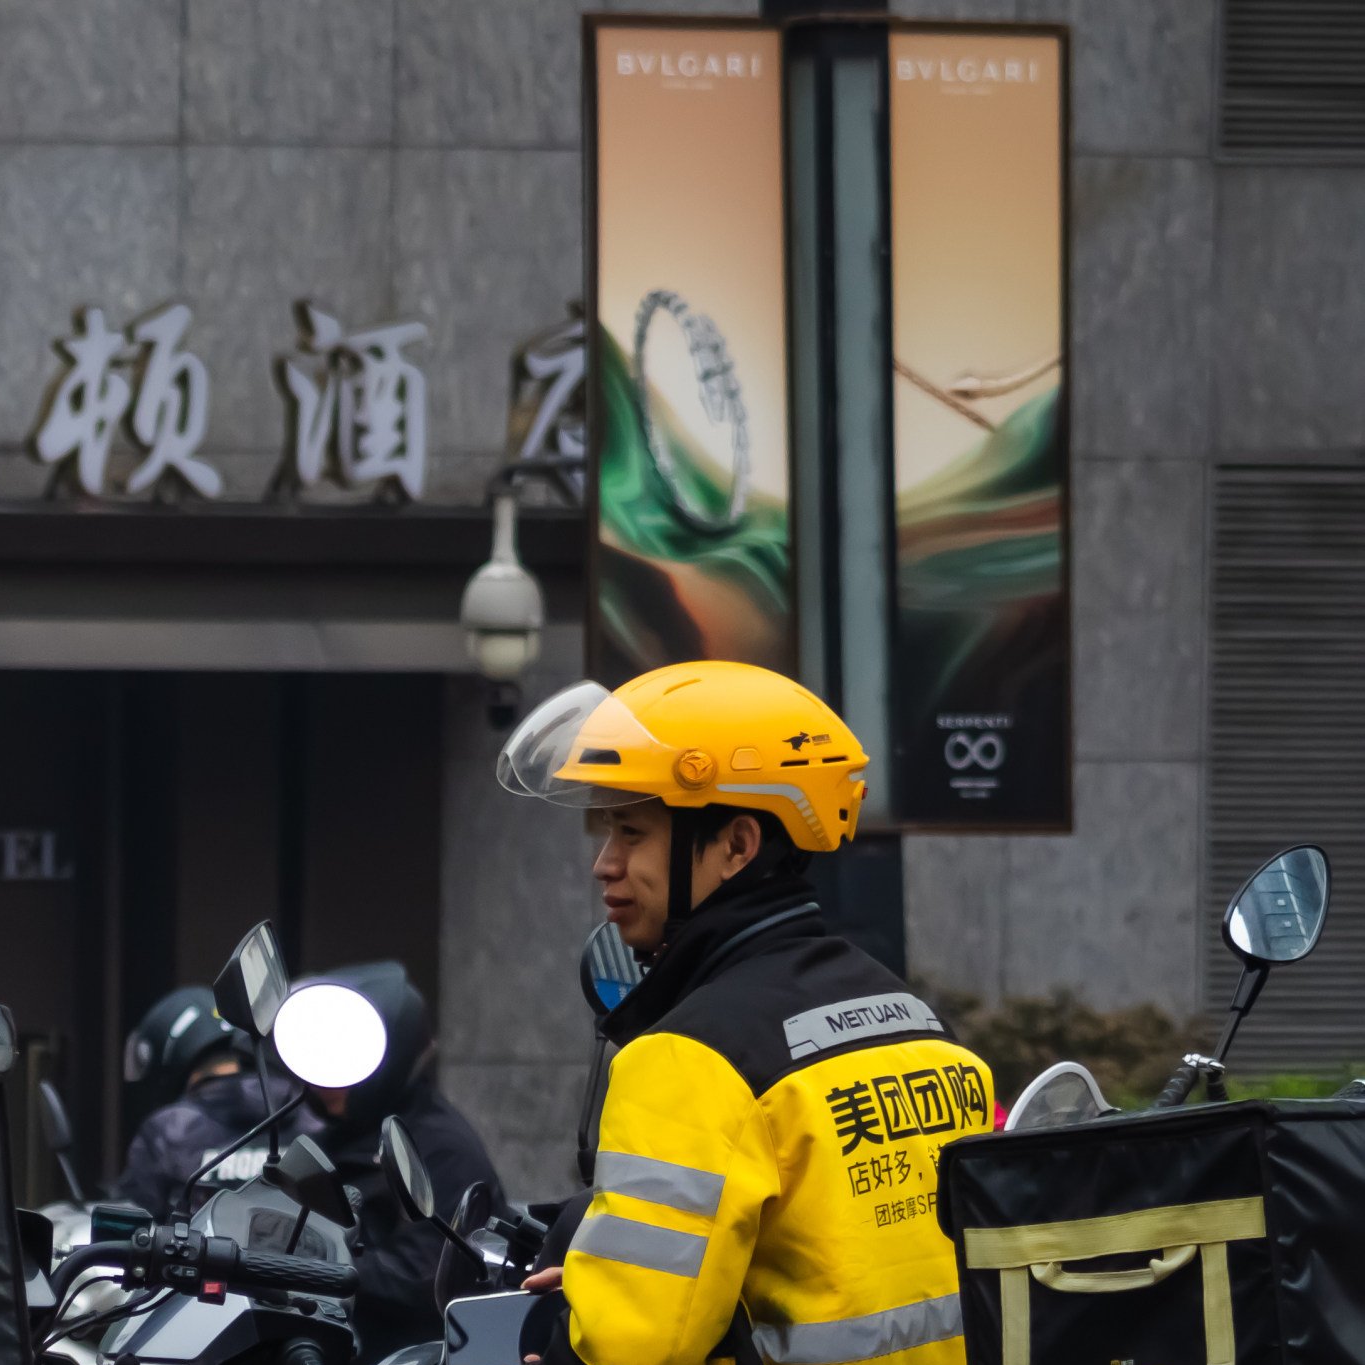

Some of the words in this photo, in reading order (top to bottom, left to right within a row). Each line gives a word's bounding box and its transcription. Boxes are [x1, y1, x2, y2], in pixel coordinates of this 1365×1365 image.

[616, 52, 762, 79] BVLGARI
[896, 57, 1039, 83] BVLGARI
[824, 1002, 912, 1034] MEITUAN
[825, 1062, 989, 1157] 美团团购
